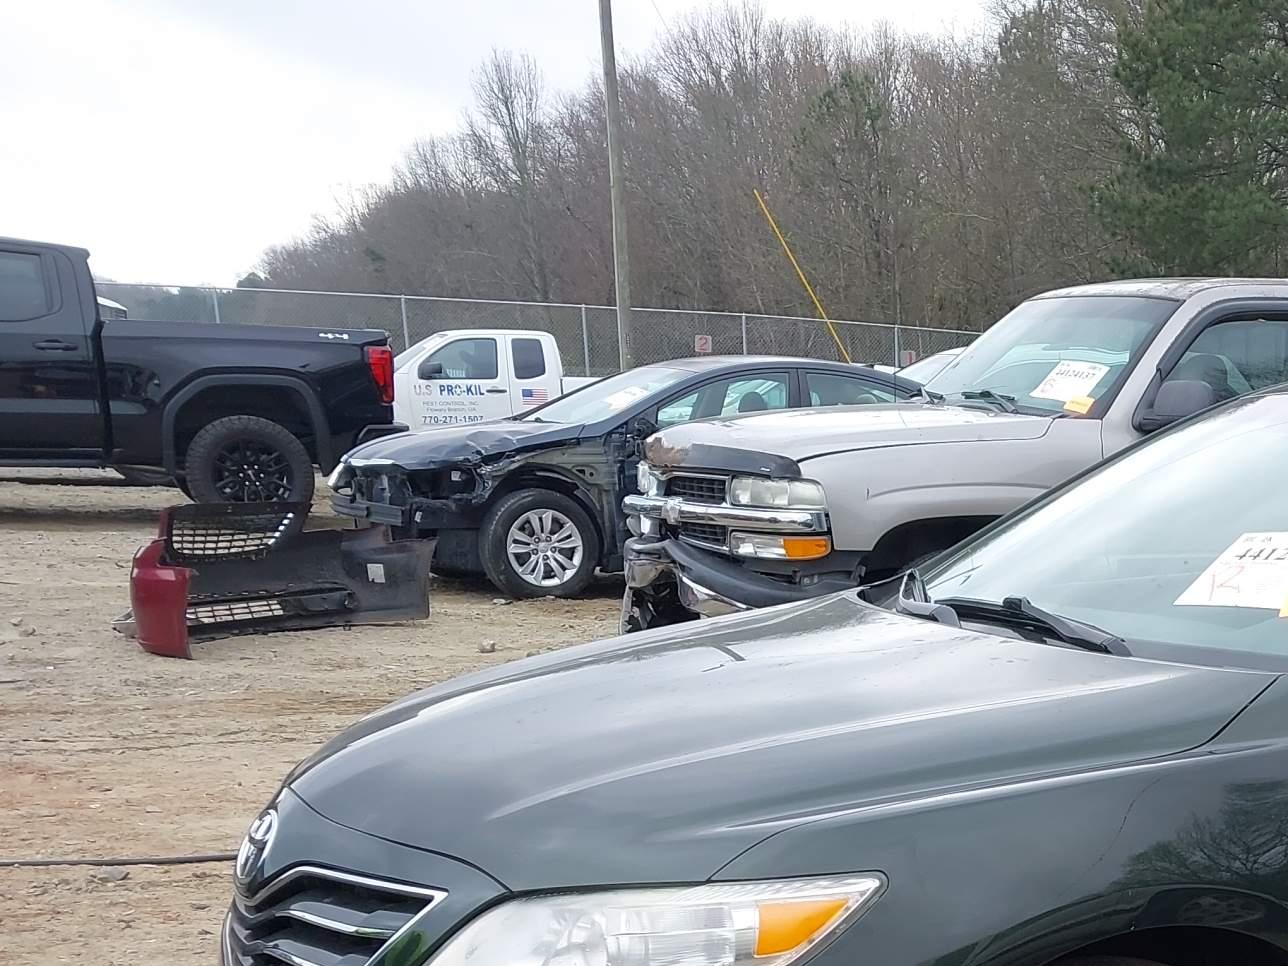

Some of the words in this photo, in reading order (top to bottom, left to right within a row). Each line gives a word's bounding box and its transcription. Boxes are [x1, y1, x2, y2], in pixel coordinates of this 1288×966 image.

[698, 336, 708, 351] 2
[439, 384, 485, 396] PRO-KIL
[422, 415, 484, 424] 770-271-1507
